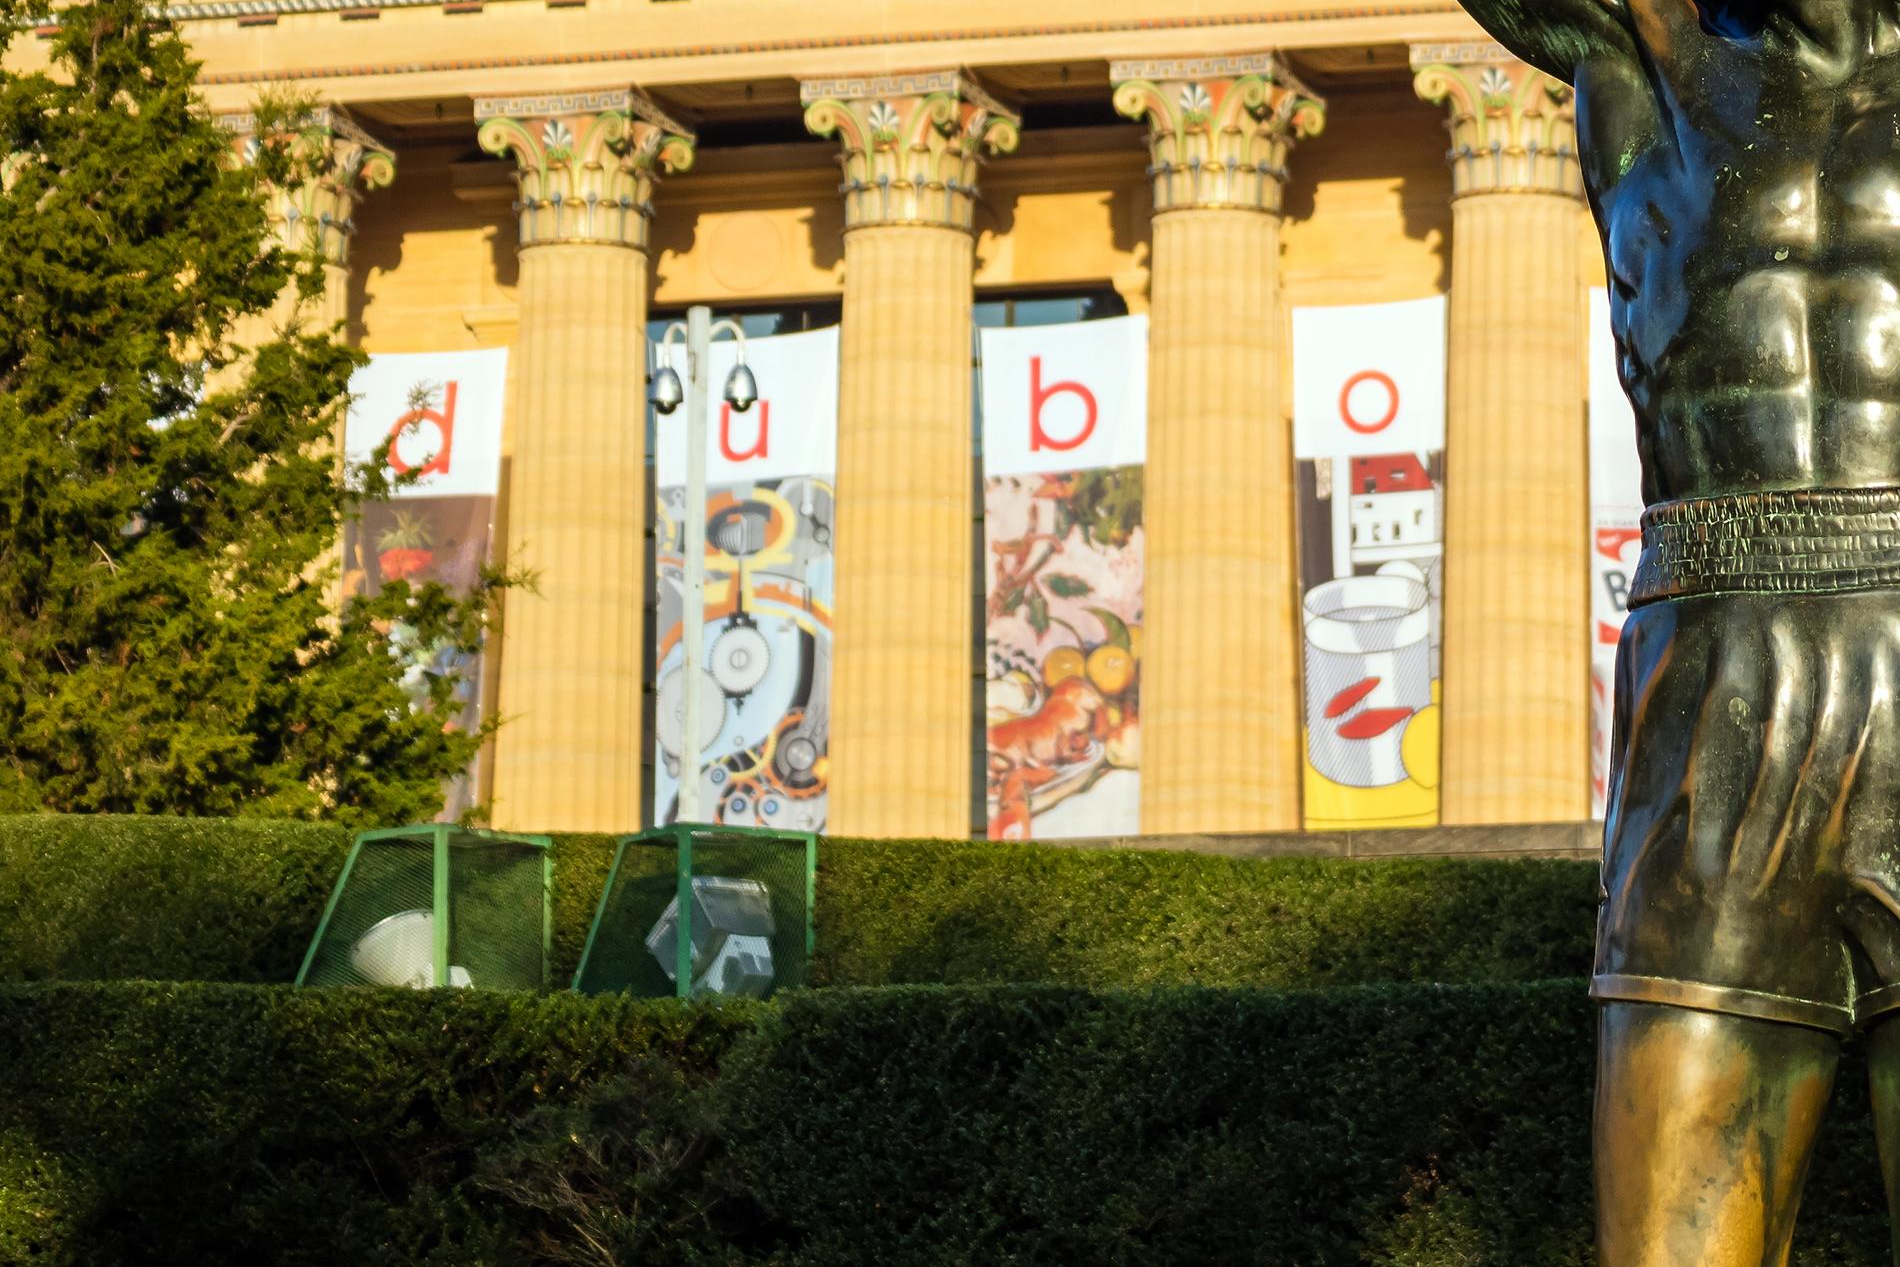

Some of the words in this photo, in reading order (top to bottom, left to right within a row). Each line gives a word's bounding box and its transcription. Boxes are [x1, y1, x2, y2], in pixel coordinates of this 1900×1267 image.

[386, 381, 457, 476] d
[719, 400, 769, 462] u
[1029, 356, 1098, 453] b
[1339, 370, 1400, 434] o
